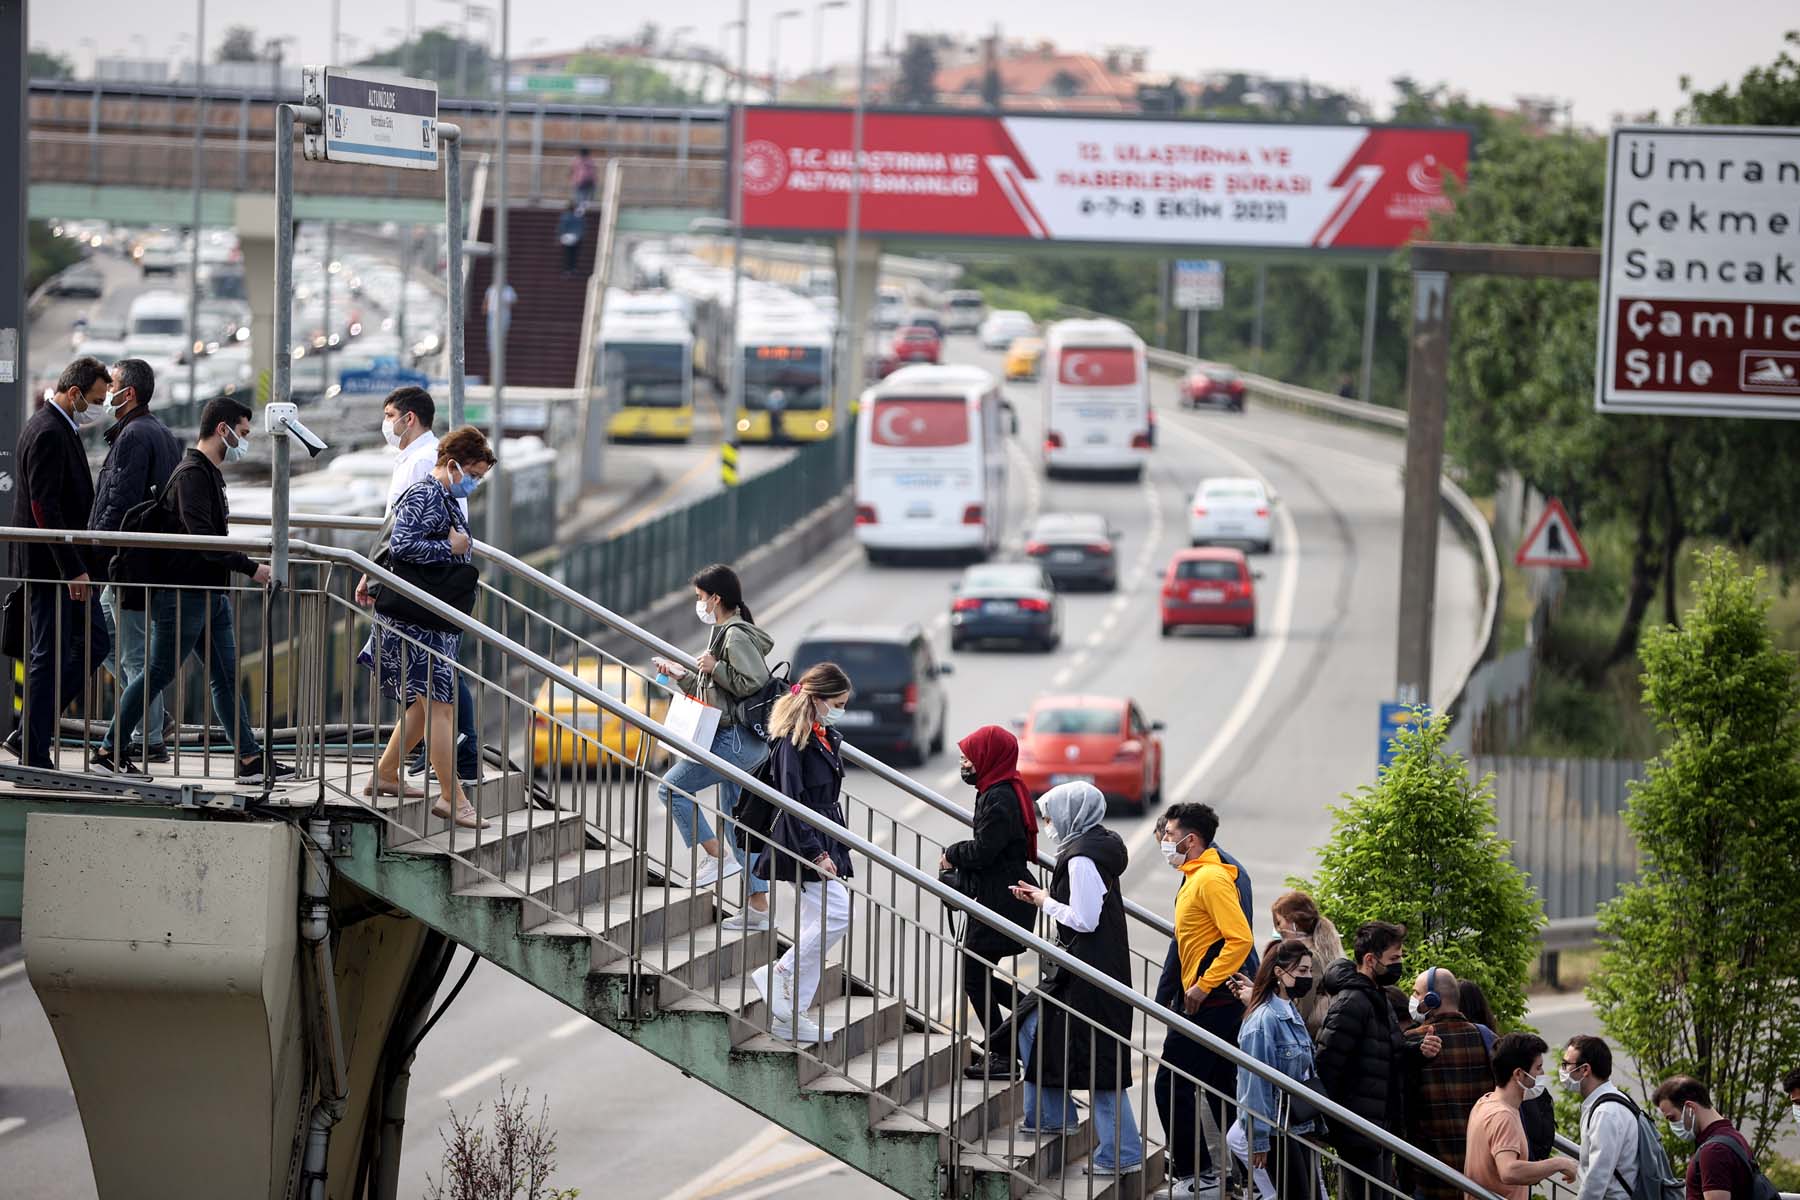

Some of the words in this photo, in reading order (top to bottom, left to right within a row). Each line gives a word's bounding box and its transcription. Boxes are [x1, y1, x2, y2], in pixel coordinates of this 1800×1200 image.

[950, 153, 978, 173] VE
[1114, 143, 1251, 169] ULAŞTIRMA
[1261, 147, 1292, 166] VE
[1629, 140, 1800, 184] Ümran
[1056, 171, 1215, 193] HABERLEŞME
[1232, 202, 1288, 222] 2021
[1624, 250, 1794, 285] Sancak
[1627, 301, 1800, 341] Çamlıc
[1625, 349, 1713, 387] Şile
